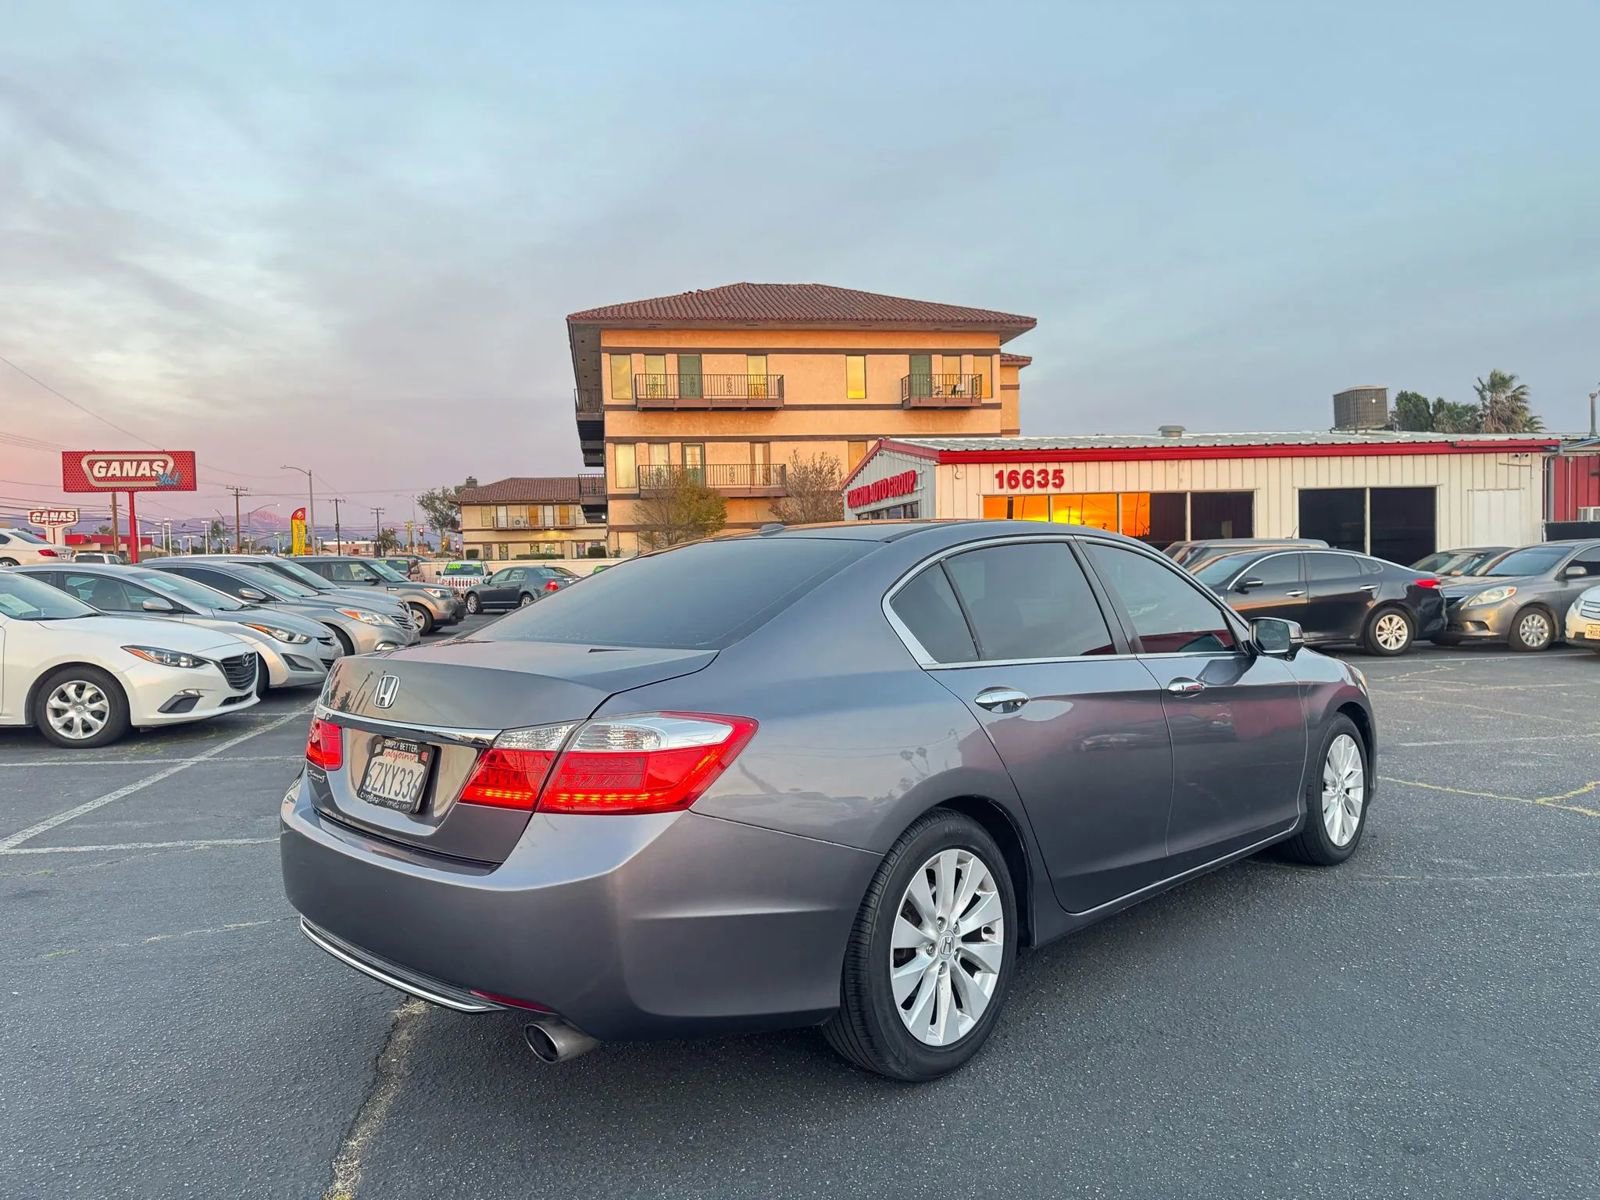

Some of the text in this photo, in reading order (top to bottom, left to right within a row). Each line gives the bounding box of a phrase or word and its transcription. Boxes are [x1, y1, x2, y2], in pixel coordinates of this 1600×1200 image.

[92, 461, 165, 478] GANAS
[994, 469, 1065, 490] 16635
[870, 477, 889, 503] AUTO
[889, 469, 917, 498] GROUP
[31, 511, 76, 523] GANAS
[363, 761, 425, 801] 6ZXY336
